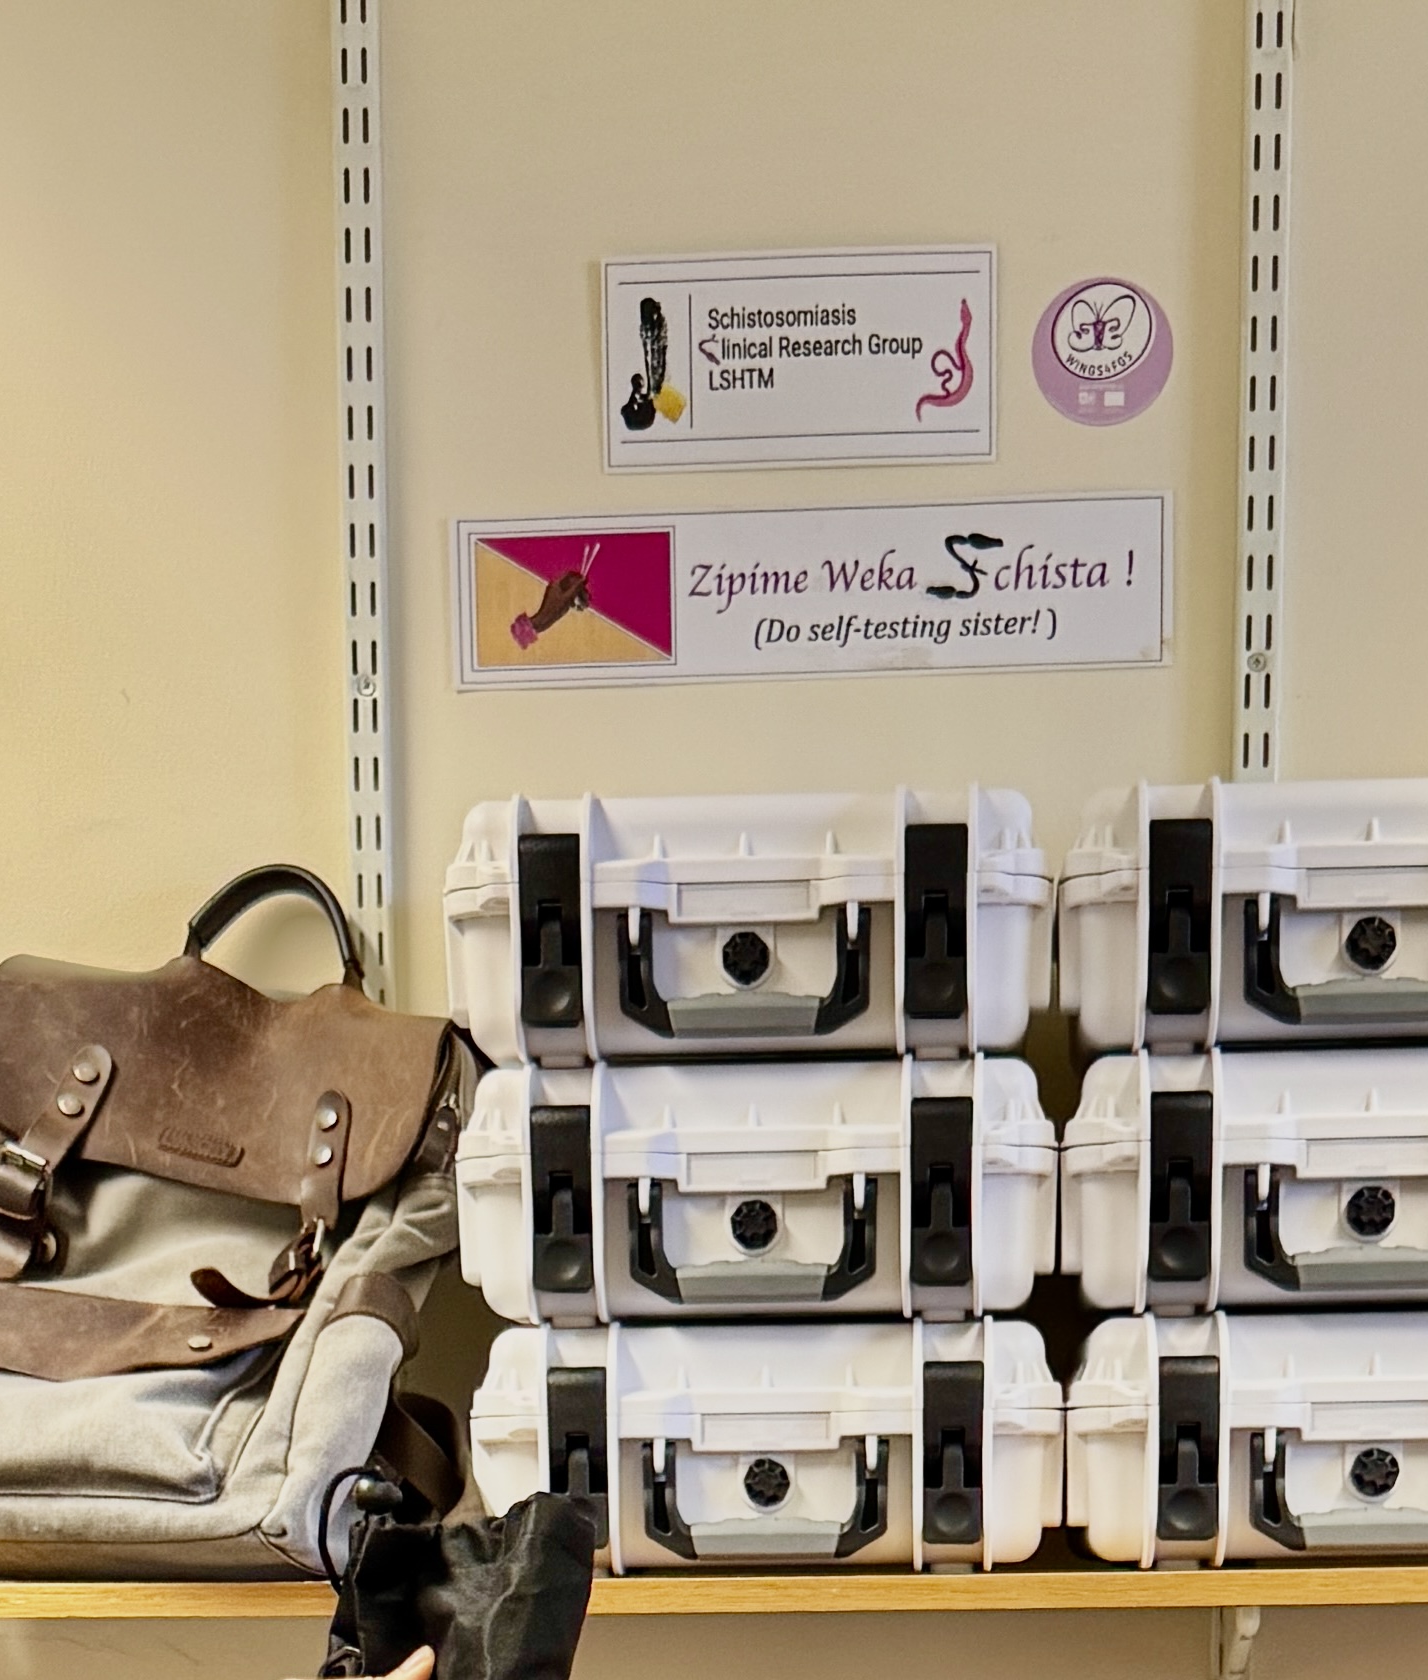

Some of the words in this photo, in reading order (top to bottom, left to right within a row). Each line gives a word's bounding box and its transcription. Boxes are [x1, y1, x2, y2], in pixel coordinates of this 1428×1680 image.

[708, 303, 857, 330] Schistosomiasis
[779, 333, 862, 358] Research
[868, 332, 923, 360] Group
[709, 367, 775, 391] LSHTM
[688, 562, 809, 614] Zipime
[821, 549, 918, 592] Weka
[754, 617, 801, 650] (Do
[807, 614, 951, 648] self-testing
